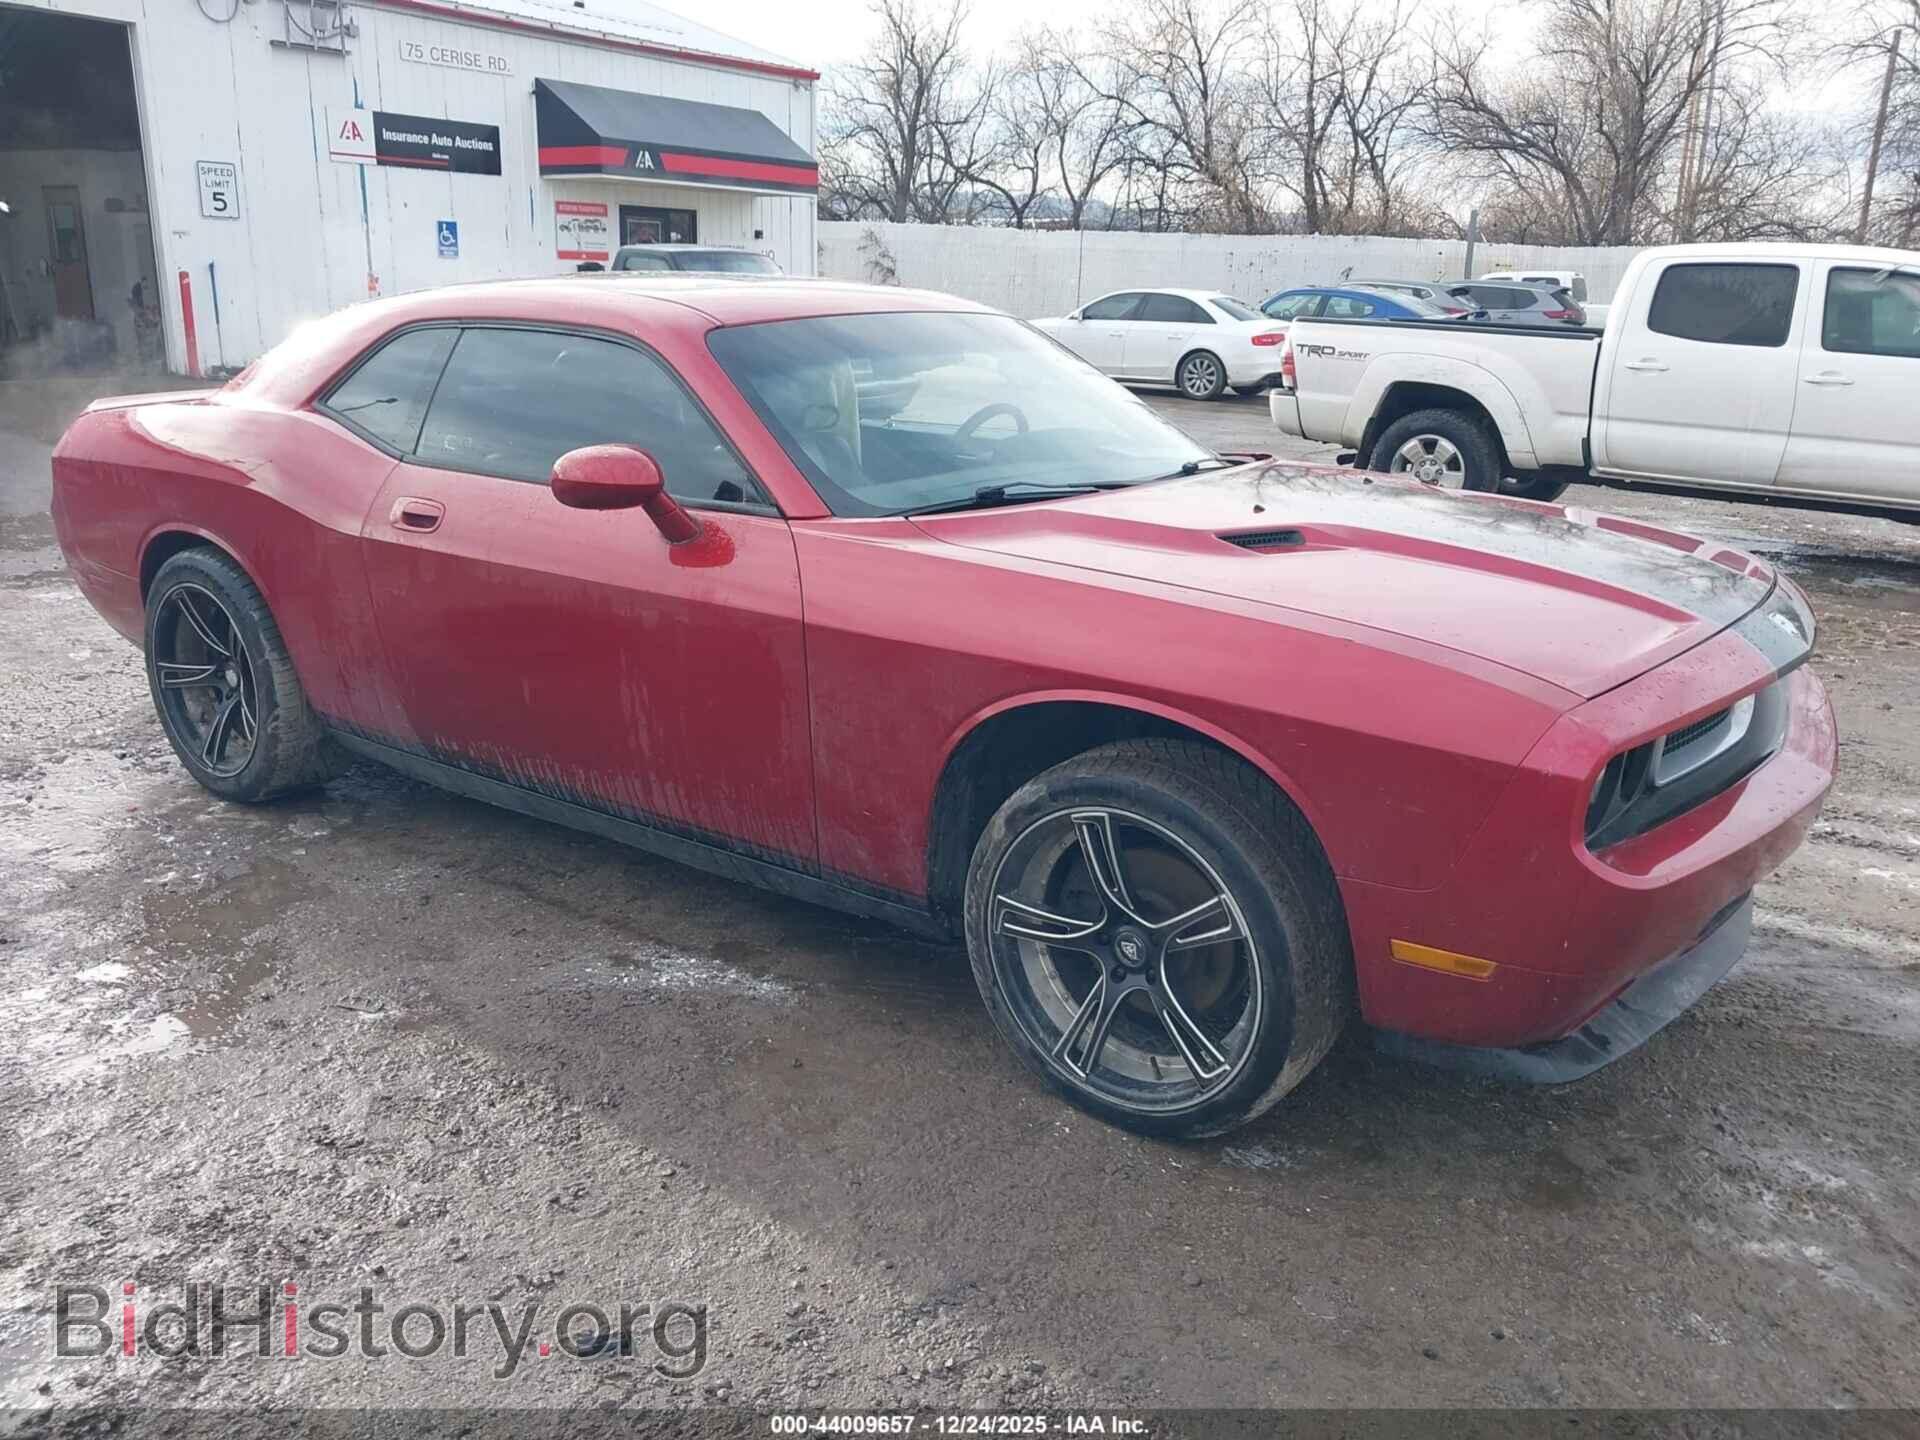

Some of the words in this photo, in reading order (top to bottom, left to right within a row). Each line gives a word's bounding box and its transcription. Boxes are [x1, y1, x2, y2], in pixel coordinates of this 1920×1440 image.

[405, 42, 424, 59] 75
[429, 46, 482, 68] CERISE
[382, 128, 429, 145] Insurance
[431, 134, 453, 147] Auto
[455, 135, 494, 151] Auctions
[200, 166, 233, 177] SPEED
[205, 179, 230, 188] LIMIT
[213, 191, 228, 212] 5
[1296, 343, 1336, 357] TRD
[1337, 350, 1370, 358] SPORT
